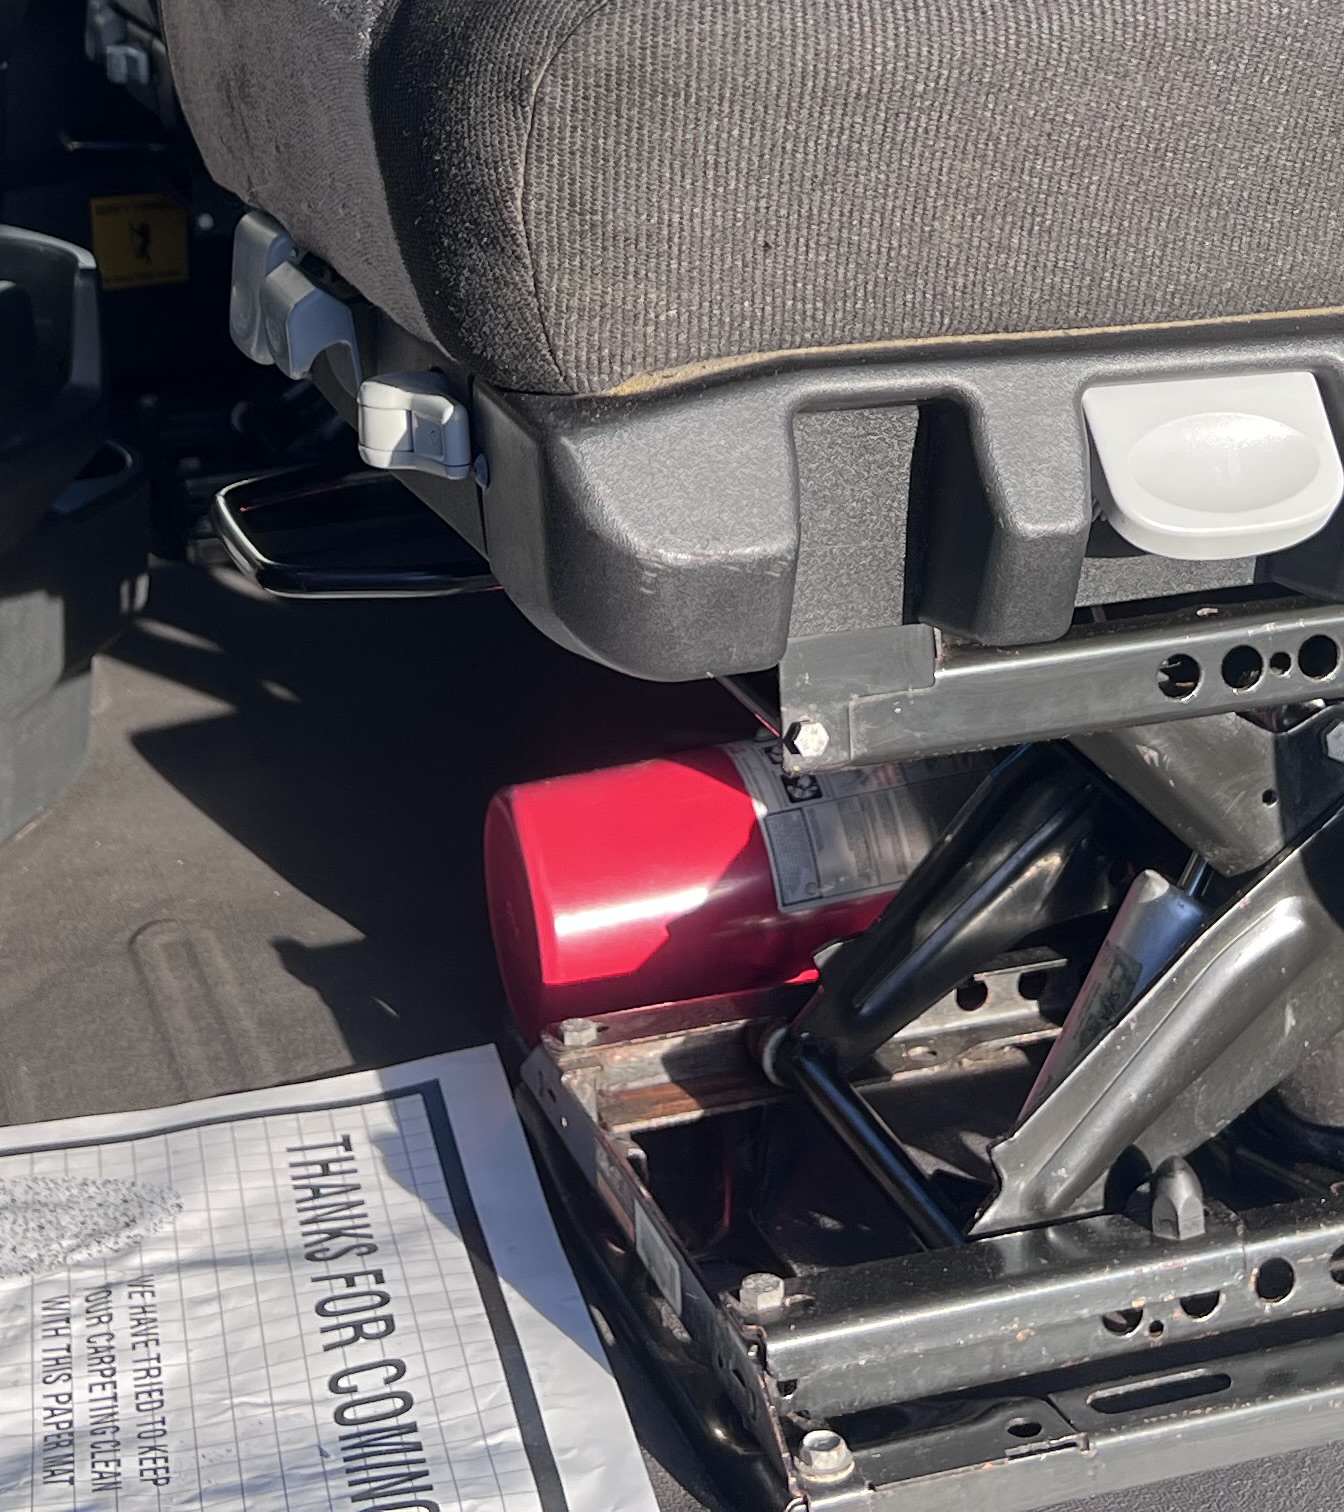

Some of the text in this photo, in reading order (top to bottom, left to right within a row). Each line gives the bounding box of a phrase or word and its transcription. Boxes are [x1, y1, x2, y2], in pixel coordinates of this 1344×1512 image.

[128, 1303, 160, 1352] HAVE
[286, 1134, 441, 1512] THANKS FOR COMIN
[41, 1294, 75, 1486] WITH THIS PAPER MAT
[86, 1331, 121, 1437] CARPETING
[132, 1353, 165, 1414] TRIED
[136, 1415, 168, 1440] TO
[90, 1439, 123, 1493] CLEAN
[138, 1444, 171, 1488] KEEP
